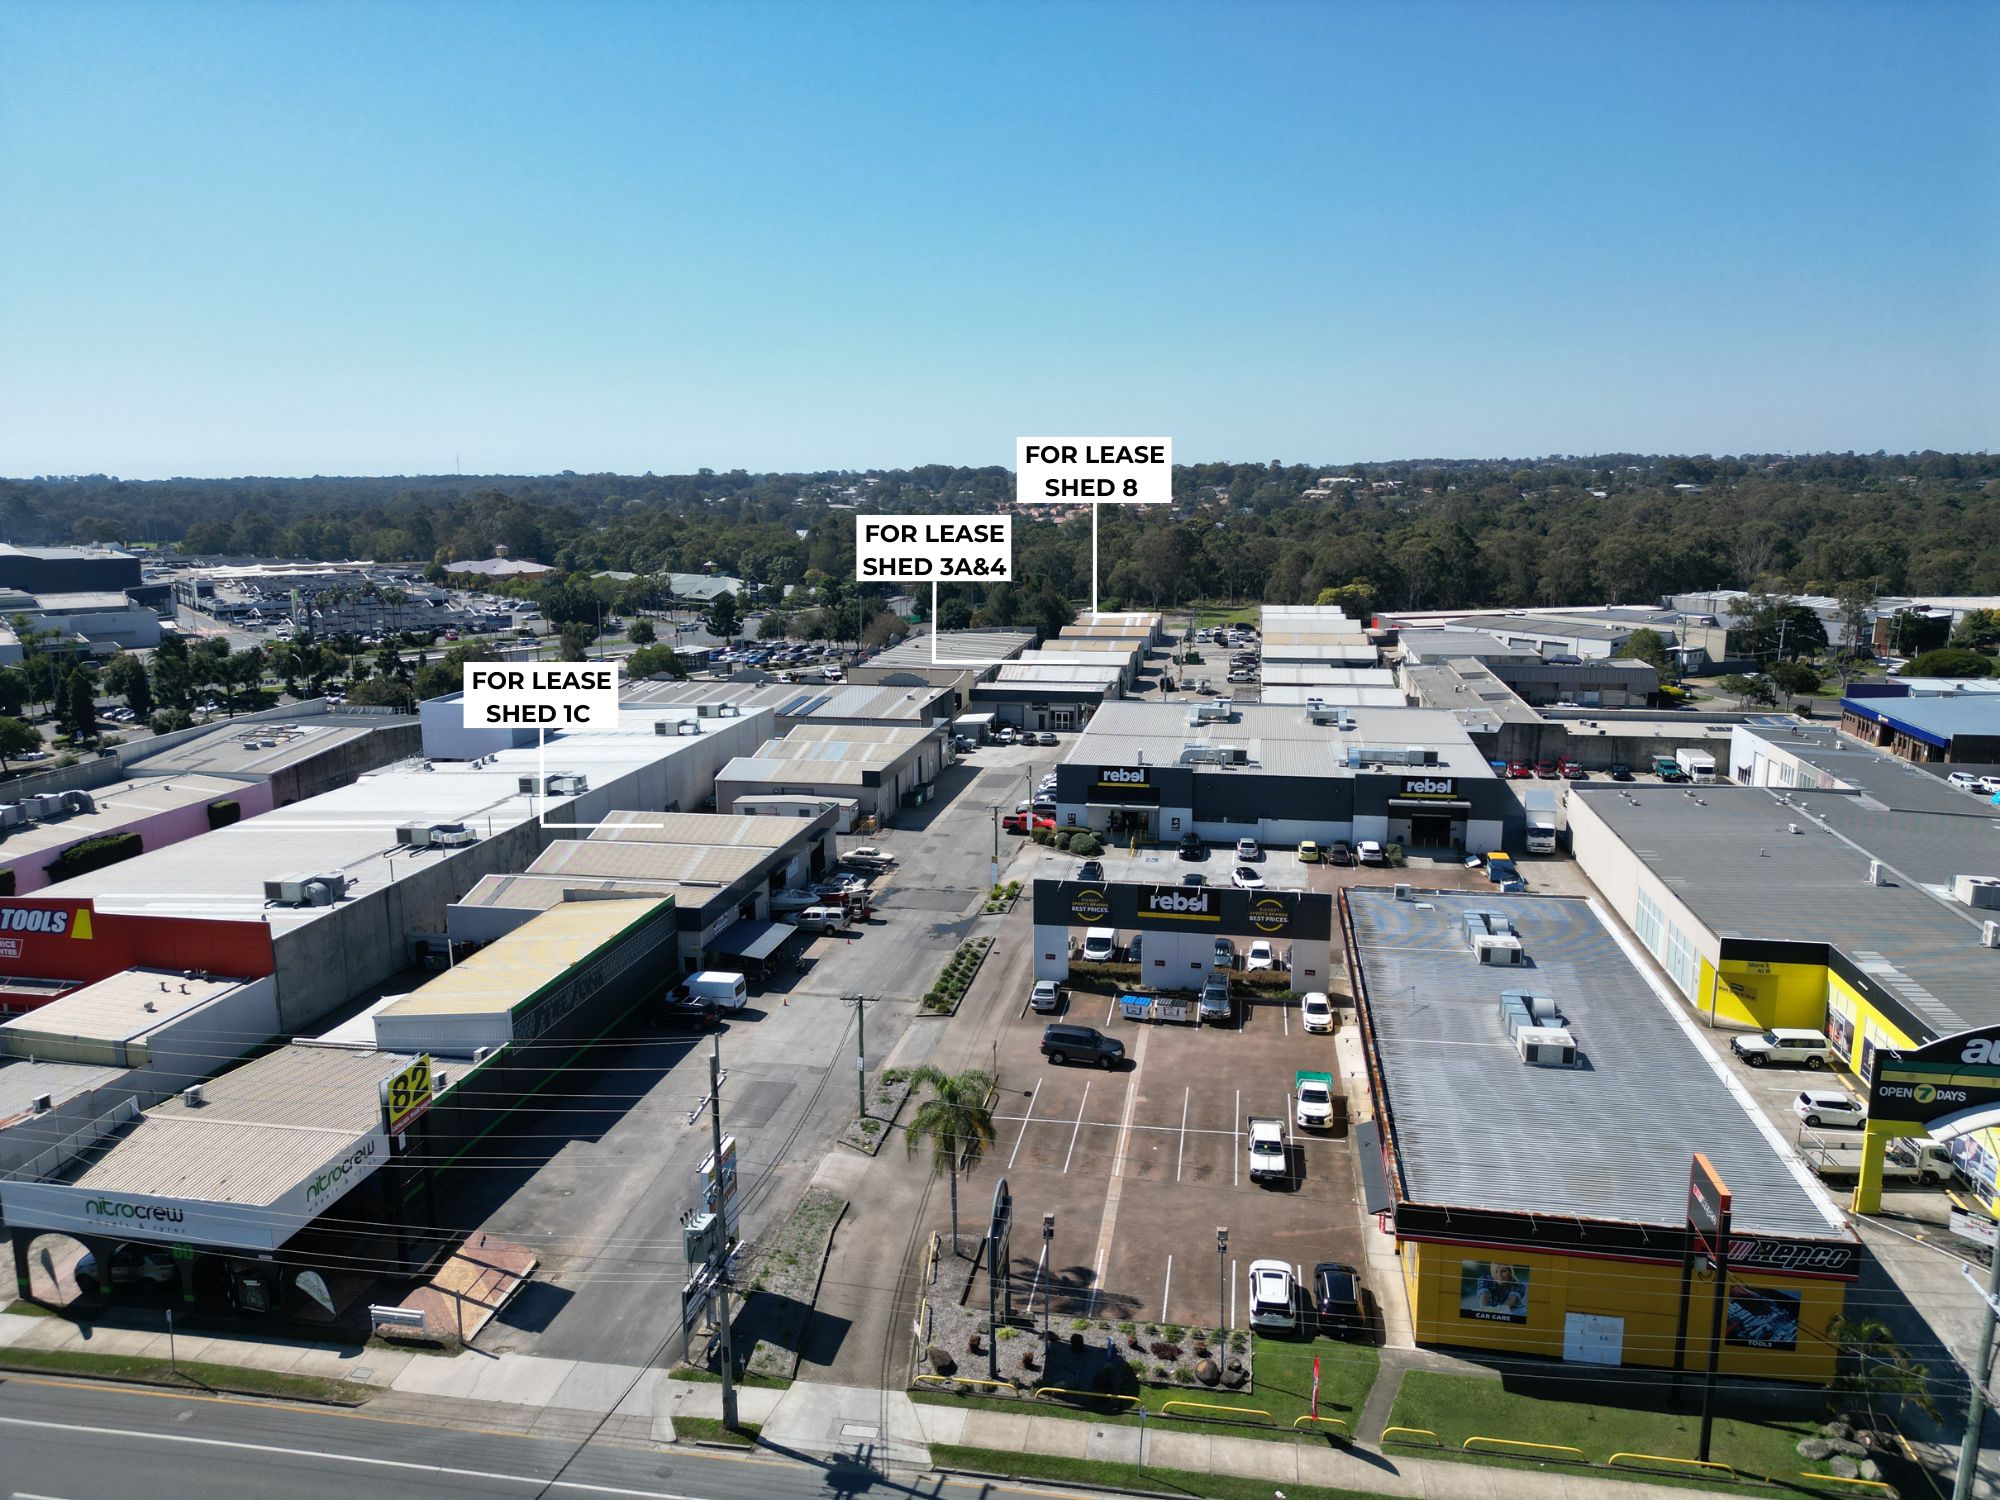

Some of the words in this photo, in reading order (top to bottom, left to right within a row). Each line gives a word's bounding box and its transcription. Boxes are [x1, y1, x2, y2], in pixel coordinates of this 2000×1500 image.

[1103, 768, 1145, 783] rebel
[1406, 778, 1452, 793] rebel
[1150, 892, 1208, 912] rebel
[1, 909, 68, 933] TOOLS
[393, 1061, 429, 1113] 82
[1879, 1086, 1913, 1098] OPEN
[1917, 1087, 1932, 1100] 7
[1936, 1090, 1967, 1102] DAYS
[306, 1139, 375, 1202] nitrocrew
[86, 1197, 184, 1222] nitrocrew
[1748, 1340, 1772, 1348] TOOLS
